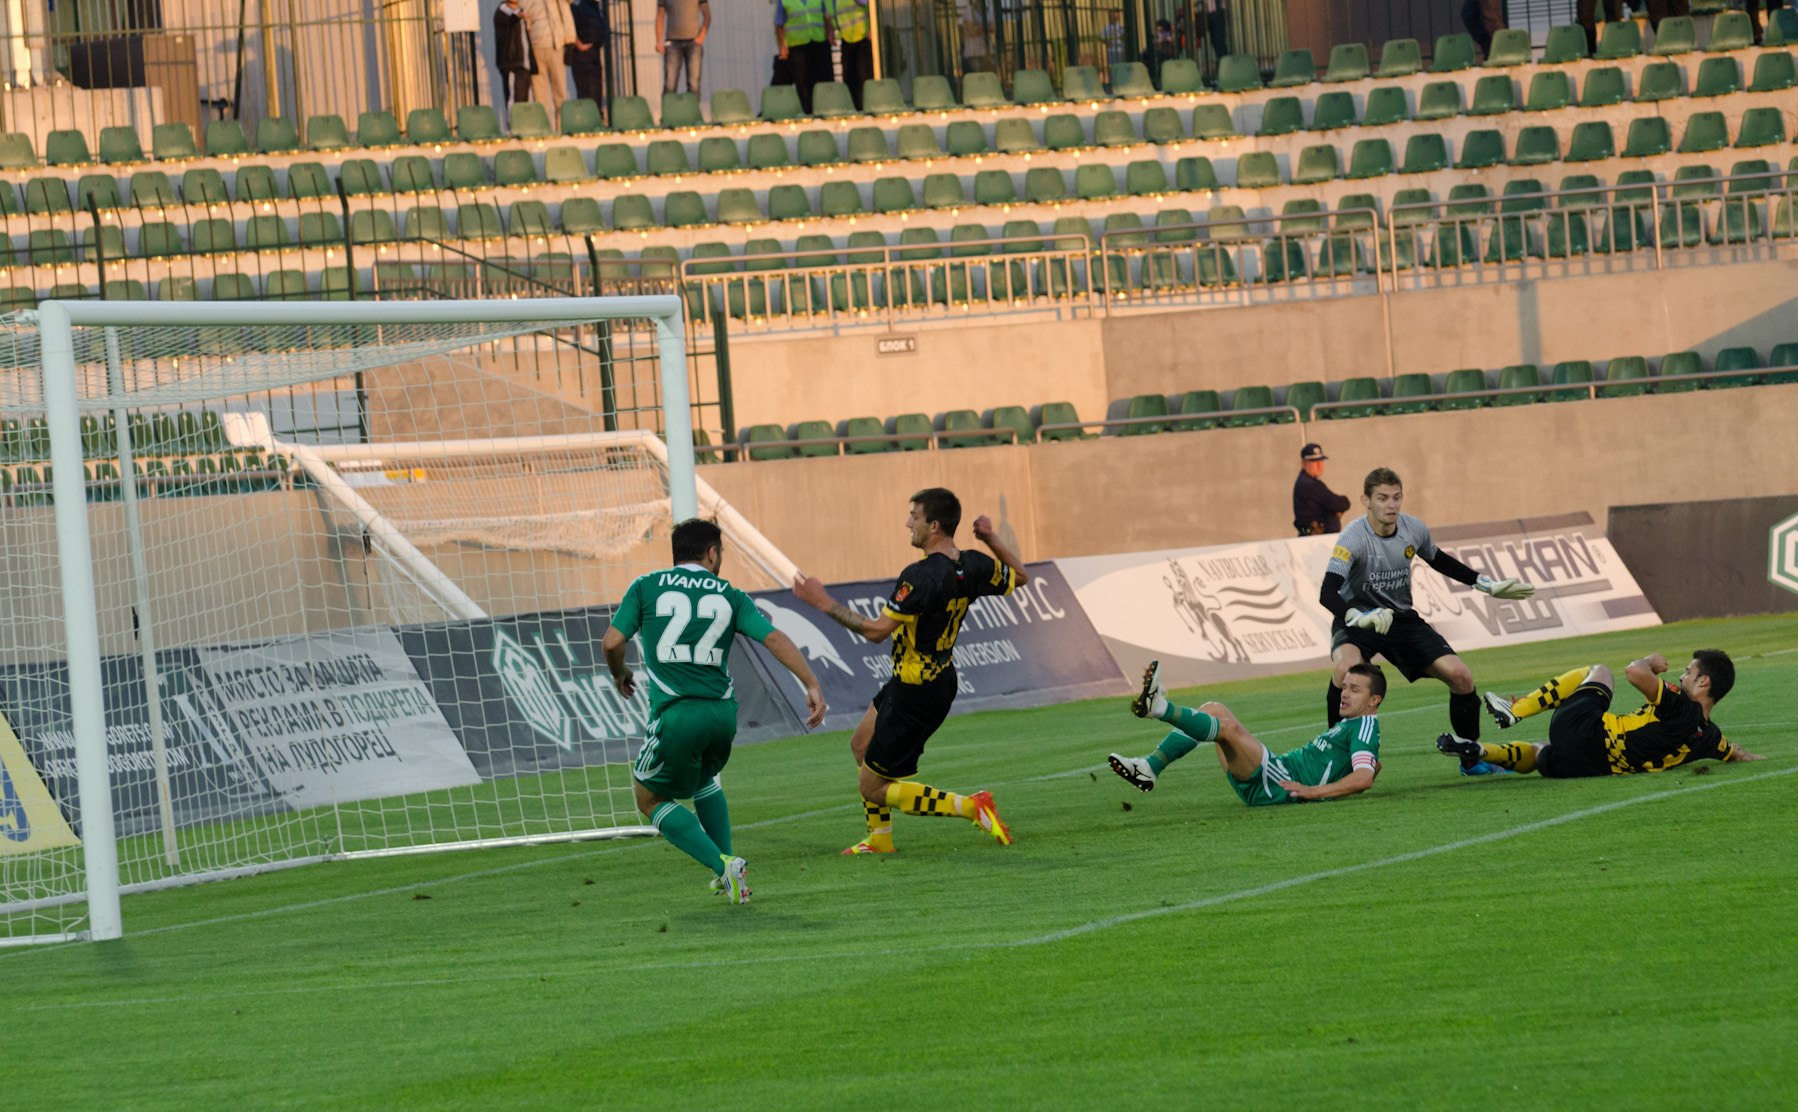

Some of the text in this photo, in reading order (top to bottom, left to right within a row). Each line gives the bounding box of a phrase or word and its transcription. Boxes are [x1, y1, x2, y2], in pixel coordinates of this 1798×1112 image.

[908, 339, 914, 351] 1
[658, 573, 728, 593] IVANOV
[1369, 567, 1410, 581] ОБЩИНА
[1011, 576, 1065, 623] PLC
[655, 590, 733, 667] 22
[1241, 628, 1298, 655] SERVICES
[952, 639, 1021, 669] ONVERSION
[214, 653, 388, 703] МЯСТО ЗА ВАШАТА
[236, 686, 436, 738] РЕКЛАМА В ПОДКРЕПА
[256, 728, 403, 776] НА ЛУДОГОРЕЦ
